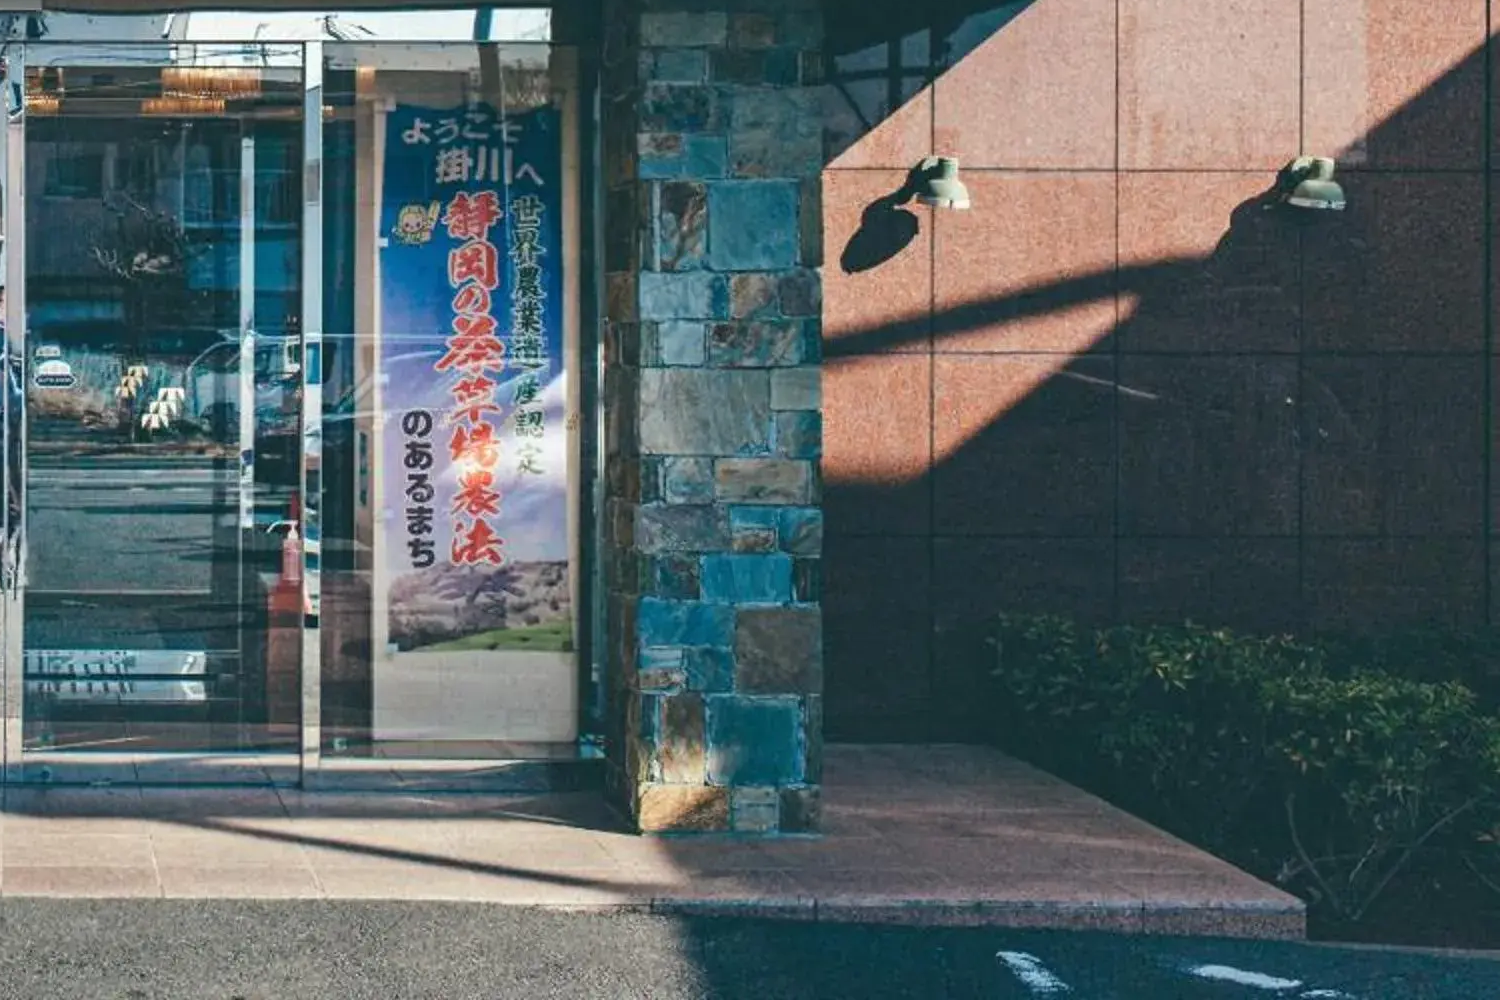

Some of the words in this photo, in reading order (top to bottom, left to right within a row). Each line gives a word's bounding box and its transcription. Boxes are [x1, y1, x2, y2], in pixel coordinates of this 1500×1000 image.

[401, 116, 523, 145] ようこそ
[435, 145, 545, 187] 掛川へ
[434, 190, 504, 565] 静岡の茶草場農法
[402, 409, 436, 568] のあるまち
